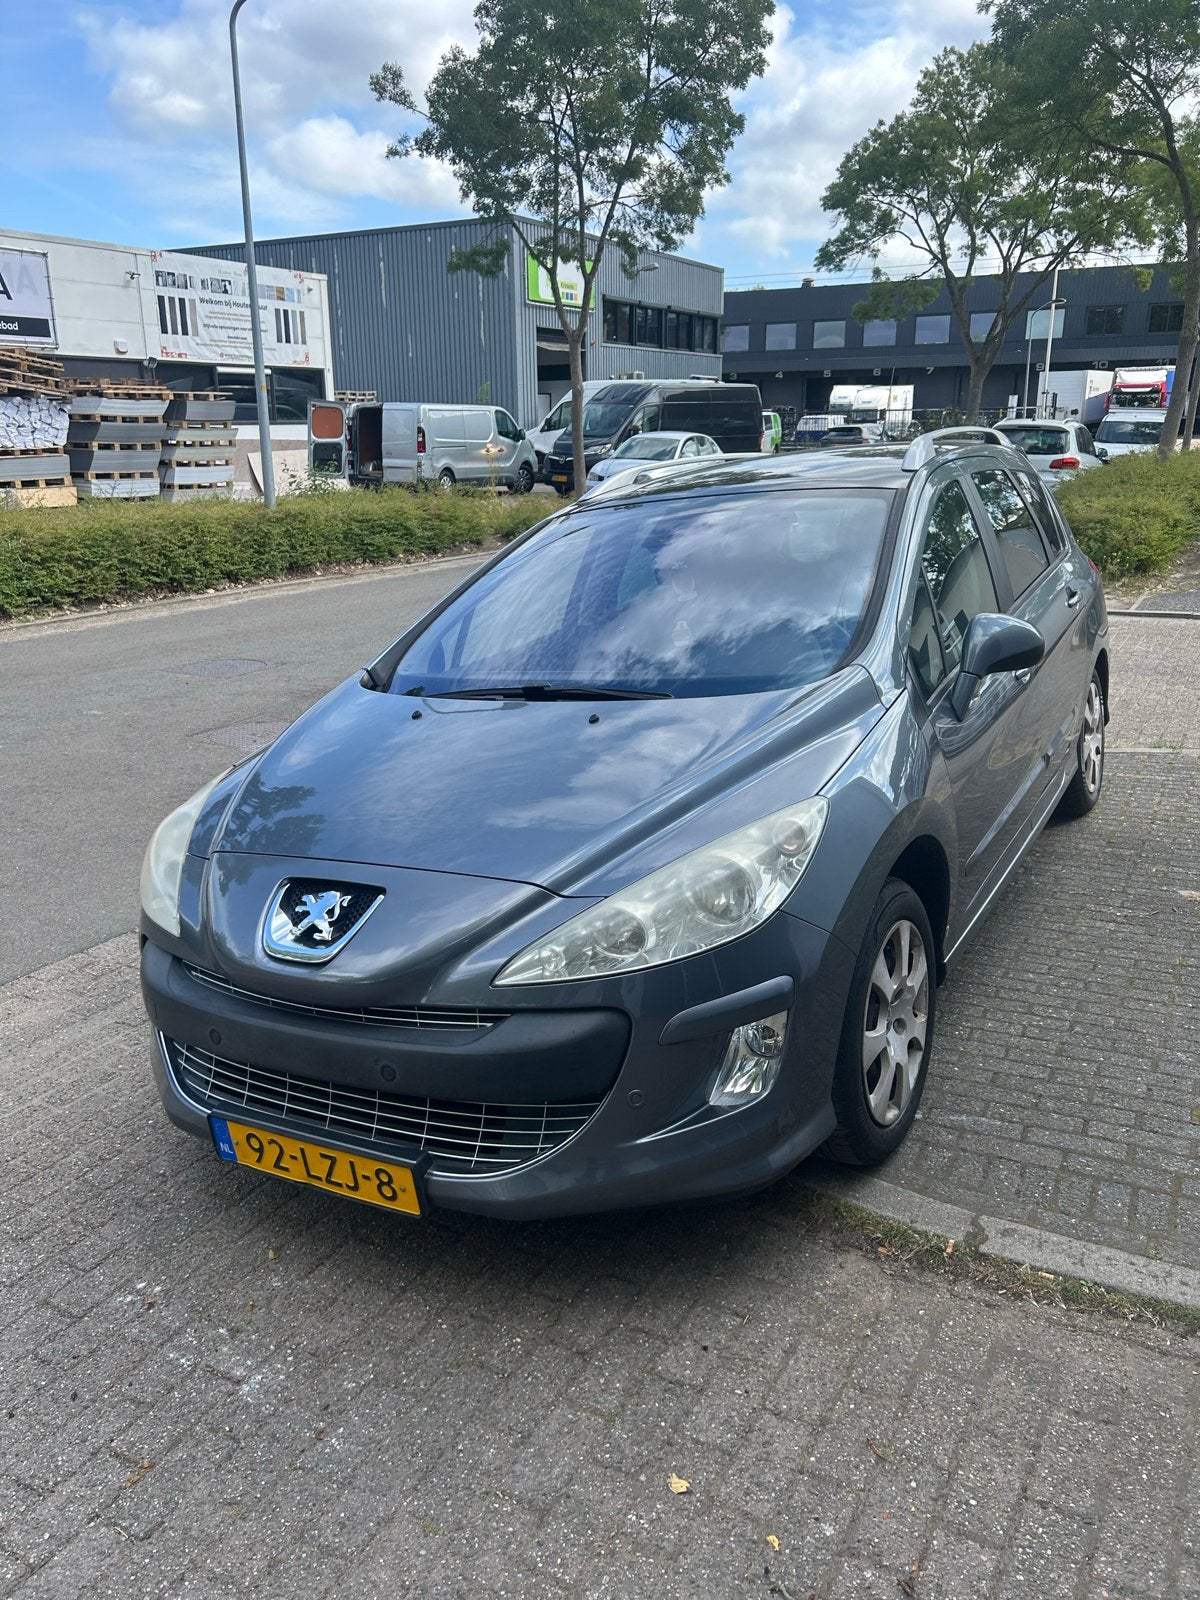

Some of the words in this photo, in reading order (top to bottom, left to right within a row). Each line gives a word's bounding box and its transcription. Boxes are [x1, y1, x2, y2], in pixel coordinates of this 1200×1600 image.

[198, 297, 224, 306] Welkom
[224, 299, 232, 309] bij
[232, 301, 268, 311] Houteuur
[1091, 360, 1109, 369] 10
[1155, 358, 1170, 366] 11
[926, 367, 935, 375] 7
[1035, 363, 1045, 371] 9
[775, 371, 784, 379] 4
[823, 370, 832, 378] 5
[872, 368, 882, 376] 6
[729, 372, 738, 381] 3
[219, 1142, 234, 1155] NL
[245, 1132, 398, 1202] 92-LZJ-8
